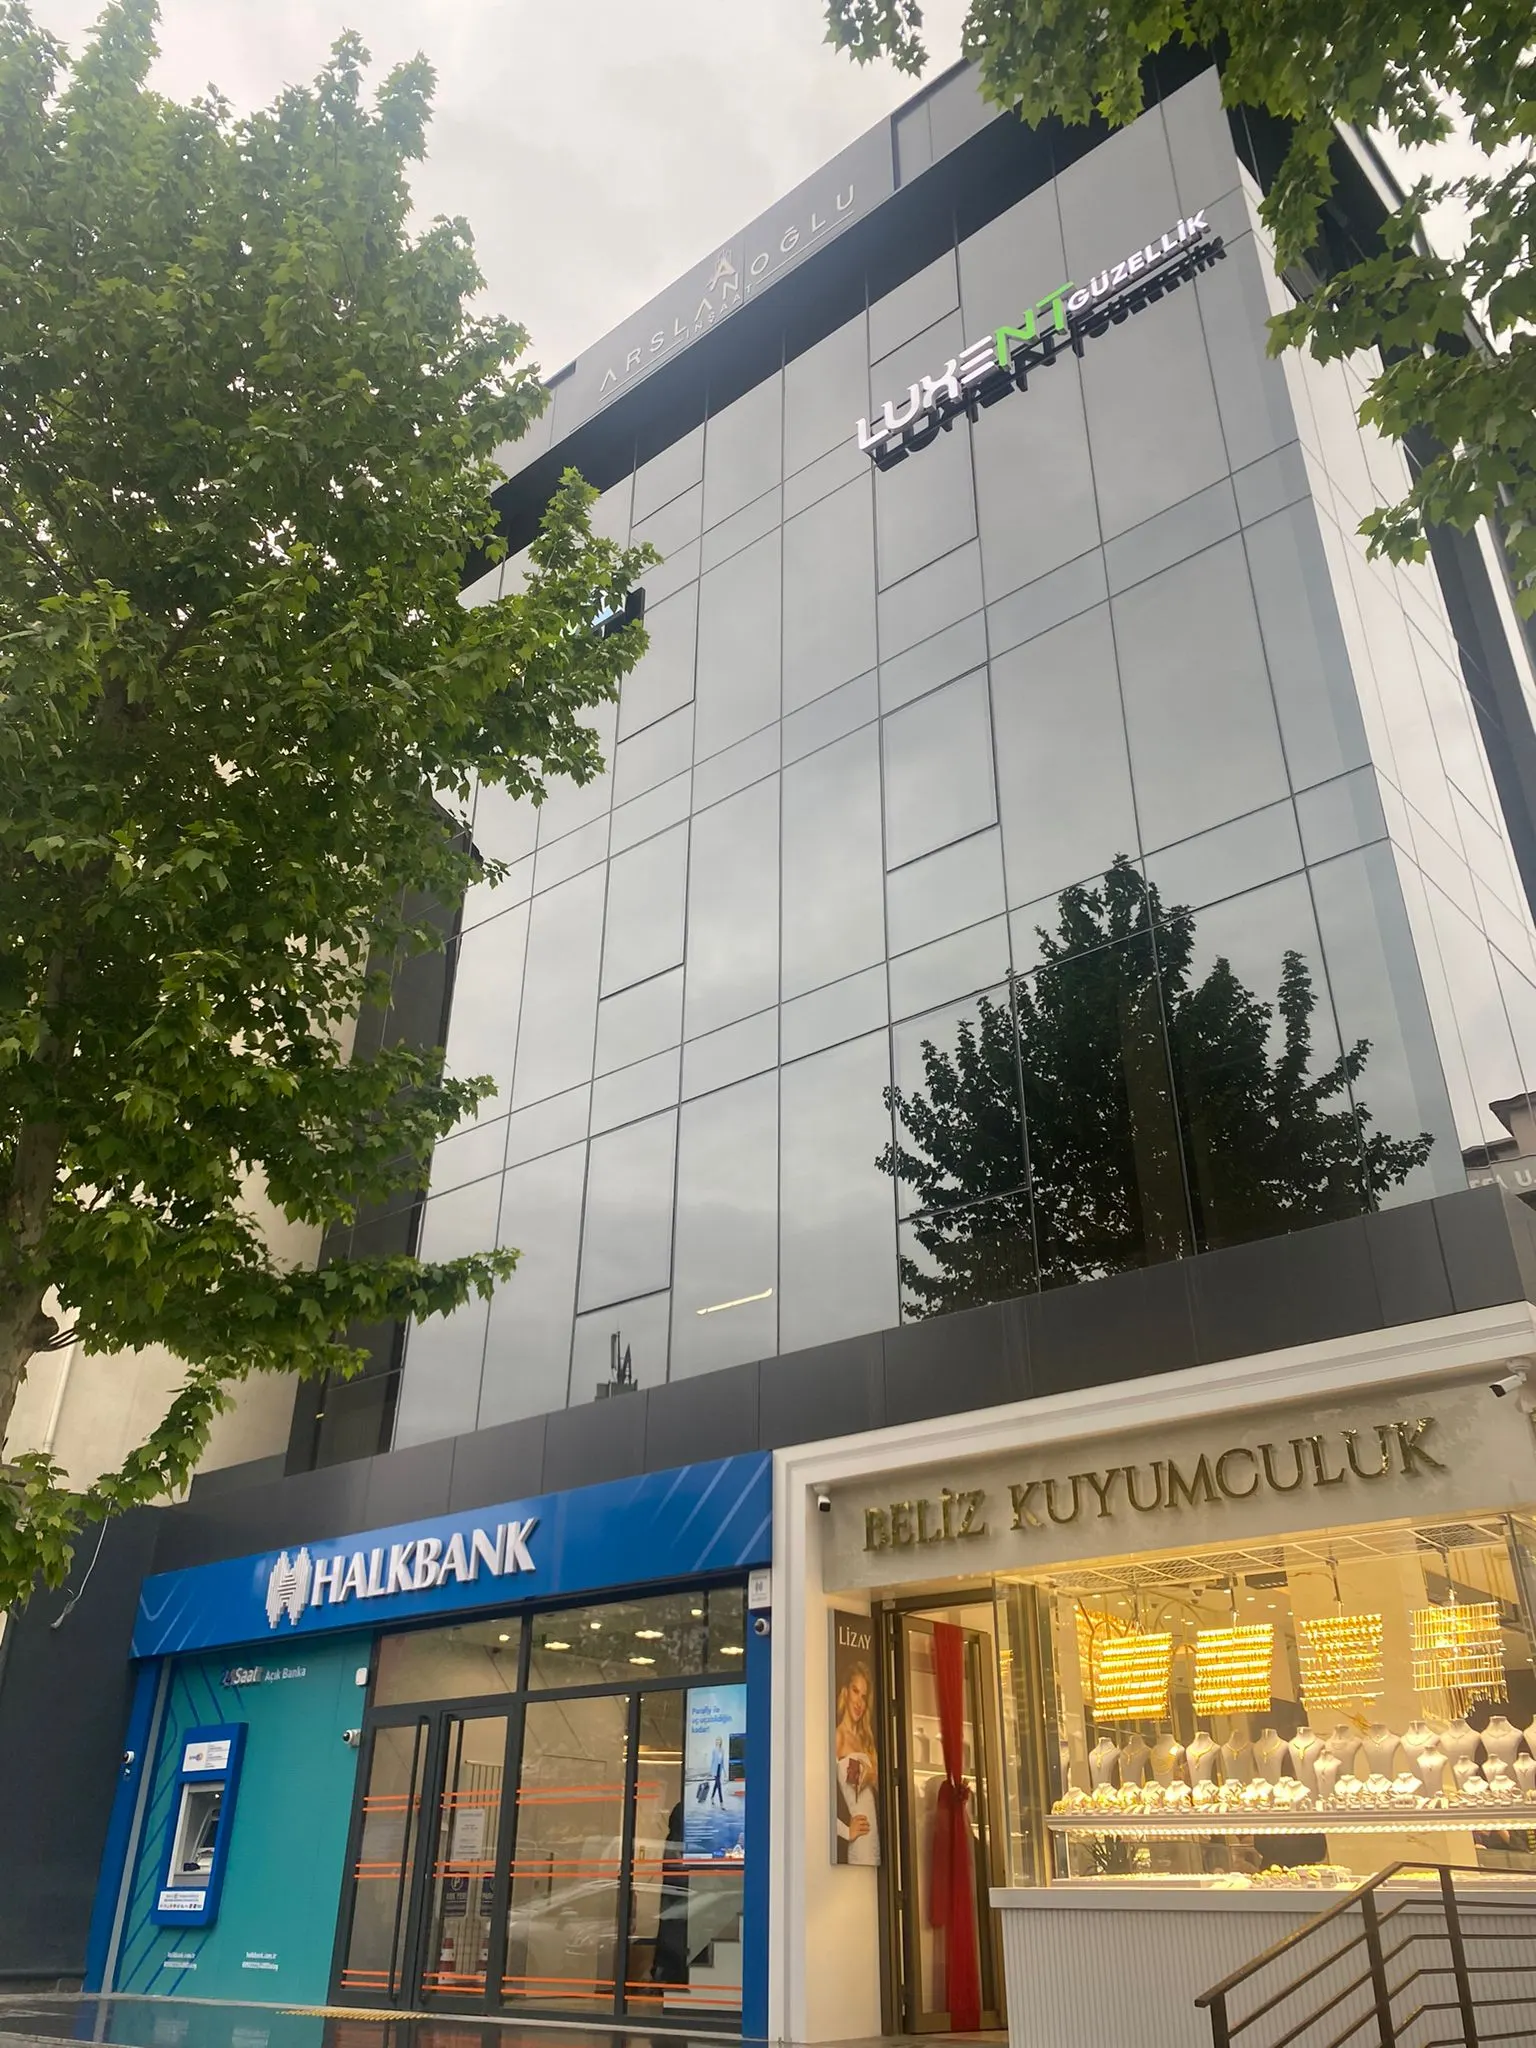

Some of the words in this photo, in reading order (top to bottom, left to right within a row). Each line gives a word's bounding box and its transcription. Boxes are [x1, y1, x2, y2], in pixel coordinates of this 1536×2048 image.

[855, 281, 1074, 451] LUXENT
[1066, 208, 1214, 314] GÜZELLİK
[863, 1486, 987, 1552] BELİZ
[1007, 1416, 1448, 1531] KUYUMCULUK
[310, 1516, 540, 1607] HALKBANK
[282, 1665, 307, 1679] Banka
